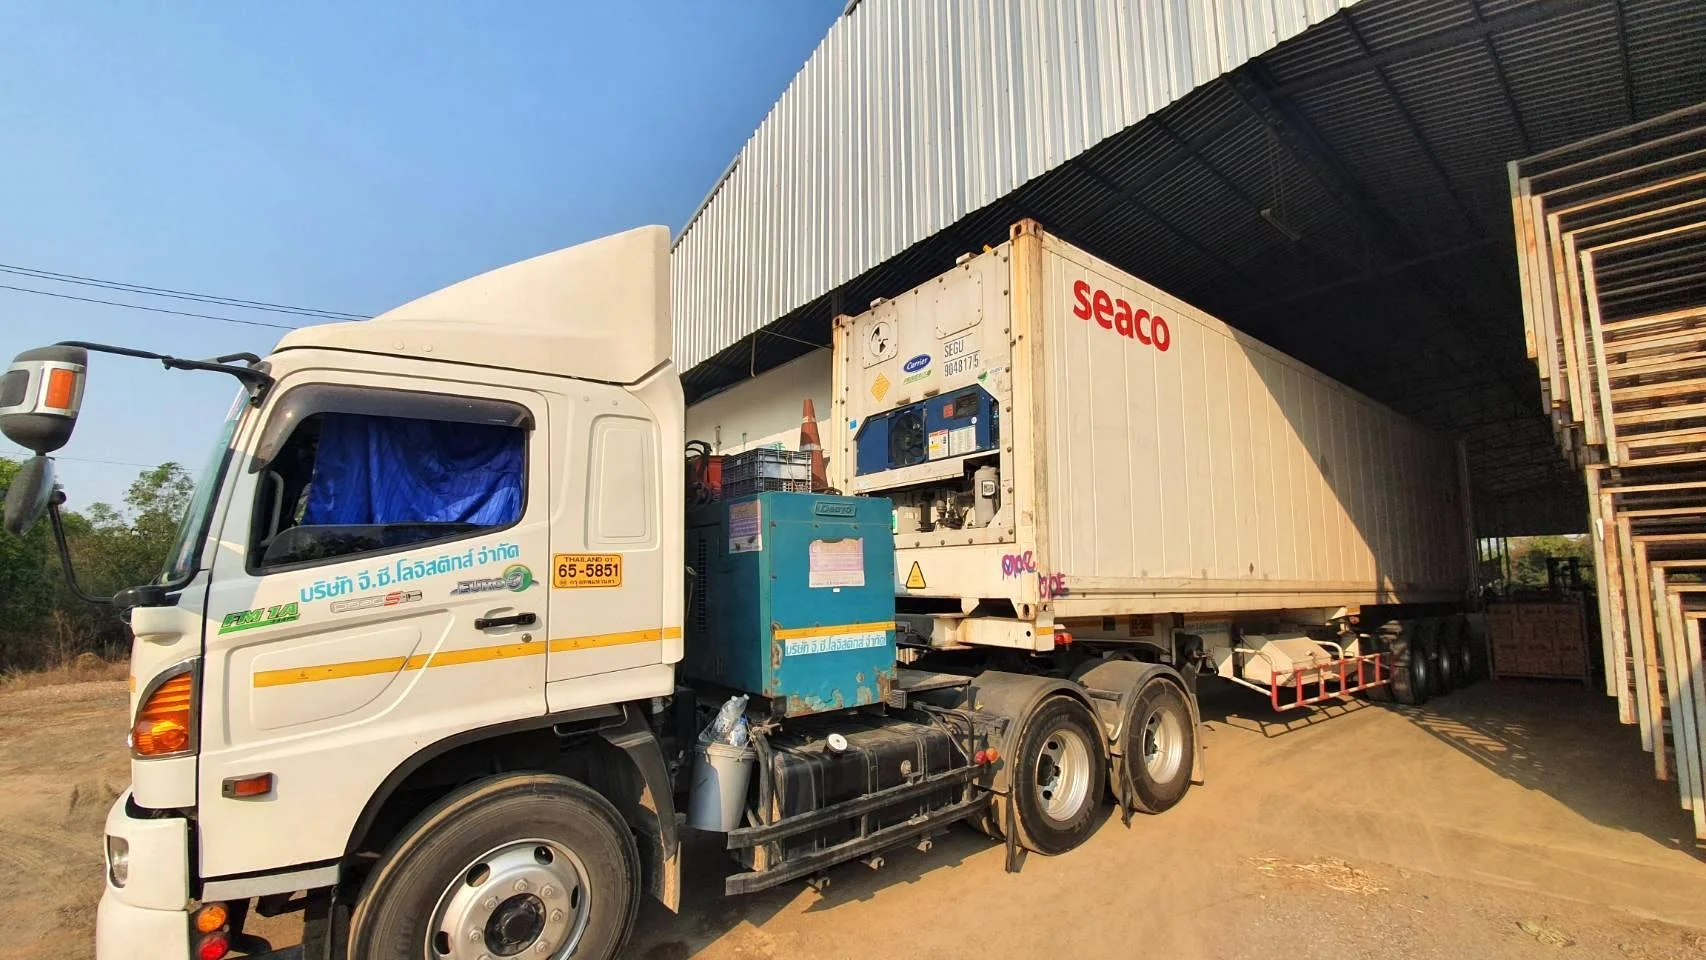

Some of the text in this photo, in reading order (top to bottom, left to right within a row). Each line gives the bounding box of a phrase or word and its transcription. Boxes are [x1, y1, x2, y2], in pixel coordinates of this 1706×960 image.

[1073, 279, 1171, 352] seaco
[944, 340, 964, 358] SEGU
[906, 356, 929, 370] Carrier
[944, 354, 979, 377] 9048175
[300, 575, 354, 602] บริษัท
[478, 542, 520, 565] จำกัด
[558, 563, 619, 578] 65-5851
[220, 608, 266, 629] FM
[267, 601, 299, 620] 1A
